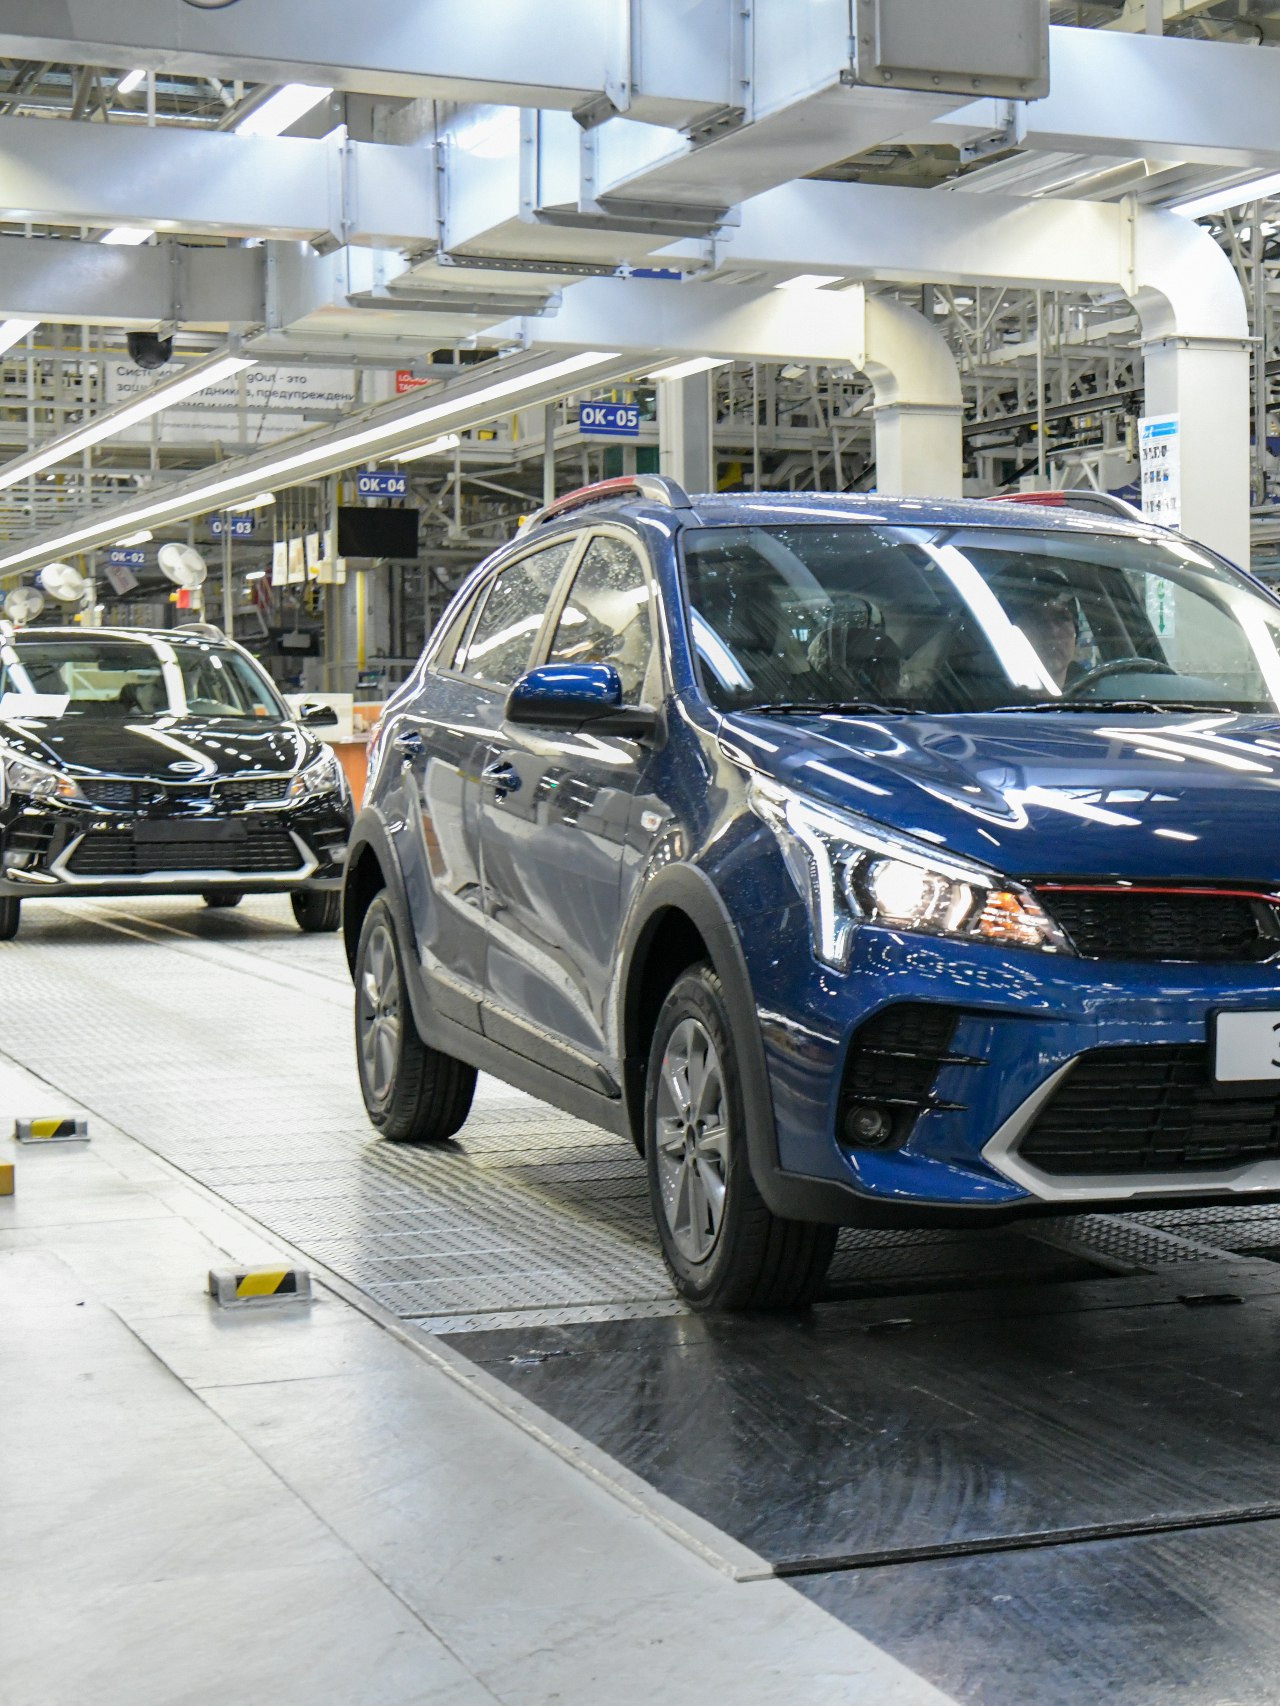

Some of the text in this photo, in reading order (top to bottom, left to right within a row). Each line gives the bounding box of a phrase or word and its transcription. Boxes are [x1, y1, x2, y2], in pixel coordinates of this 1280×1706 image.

[286, 374, 307, 384] это
[256, 388, 356, 401] предупреждени
[581, 407, 638, 427] OK-05
[360, 477, 406, 492] OK-04
[212, 521, 252, 534] O-03
[111, 551, 145, 563] OK-02
